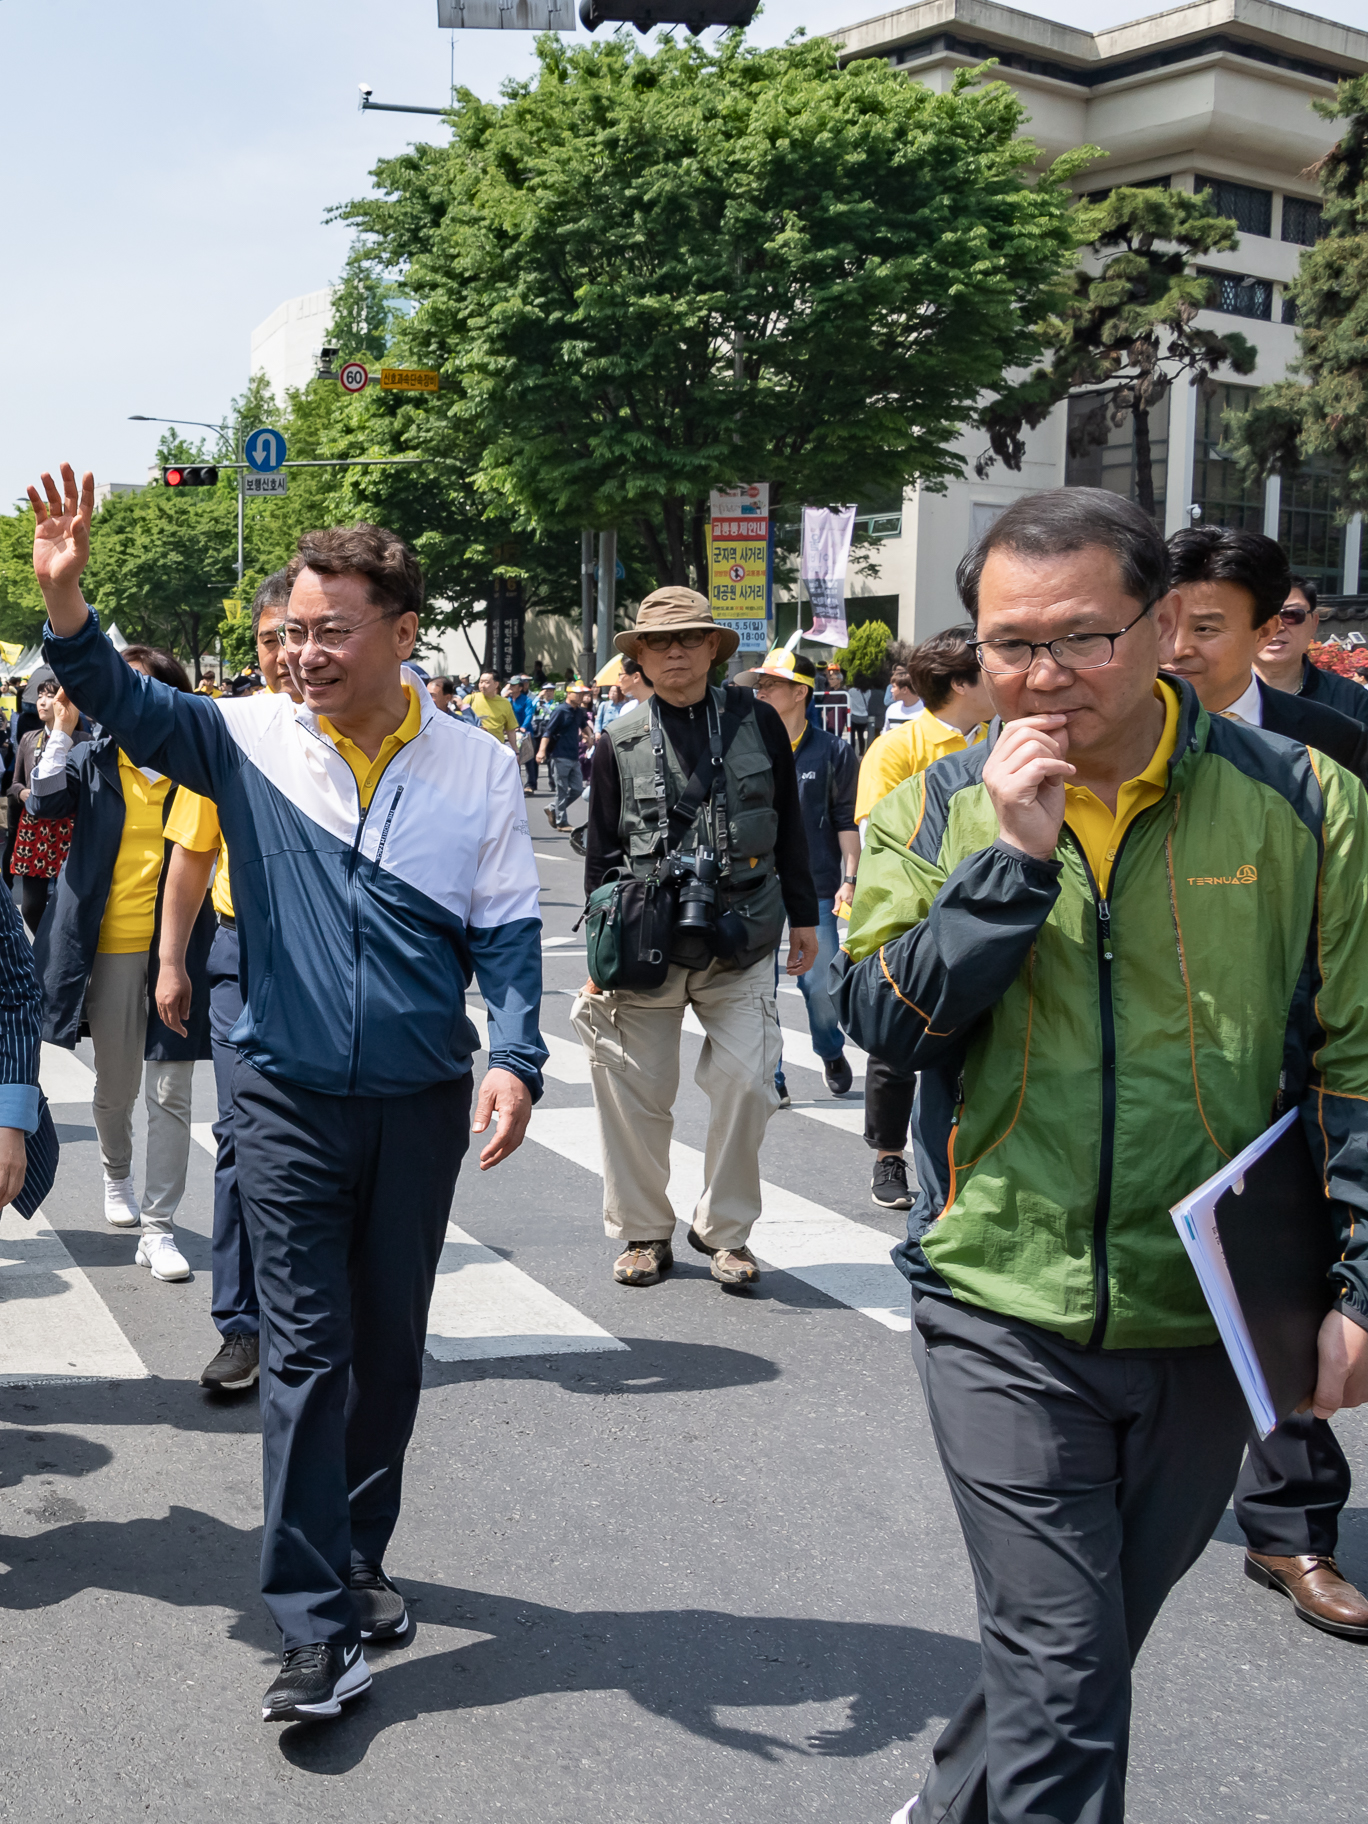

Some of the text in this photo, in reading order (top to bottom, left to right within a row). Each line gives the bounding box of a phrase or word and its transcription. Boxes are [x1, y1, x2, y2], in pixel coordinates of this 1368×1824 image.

[346, 370, 363, 385] 60
[384, 372, 437, 388] 신호과속단속장비
[246, 477, 285, 491] 보행신호시
[713, 522, 766, 536] 교통통제안내
[714, 547, 765, 563] 군자역 사거리
[713, 585, 764, 601] 대공원 사거리
[741, 632, 765, 641] 18:00
[504, 619, 512, 673] 어린이대공원
[1187, 876, 1240, 886] TERNUA
